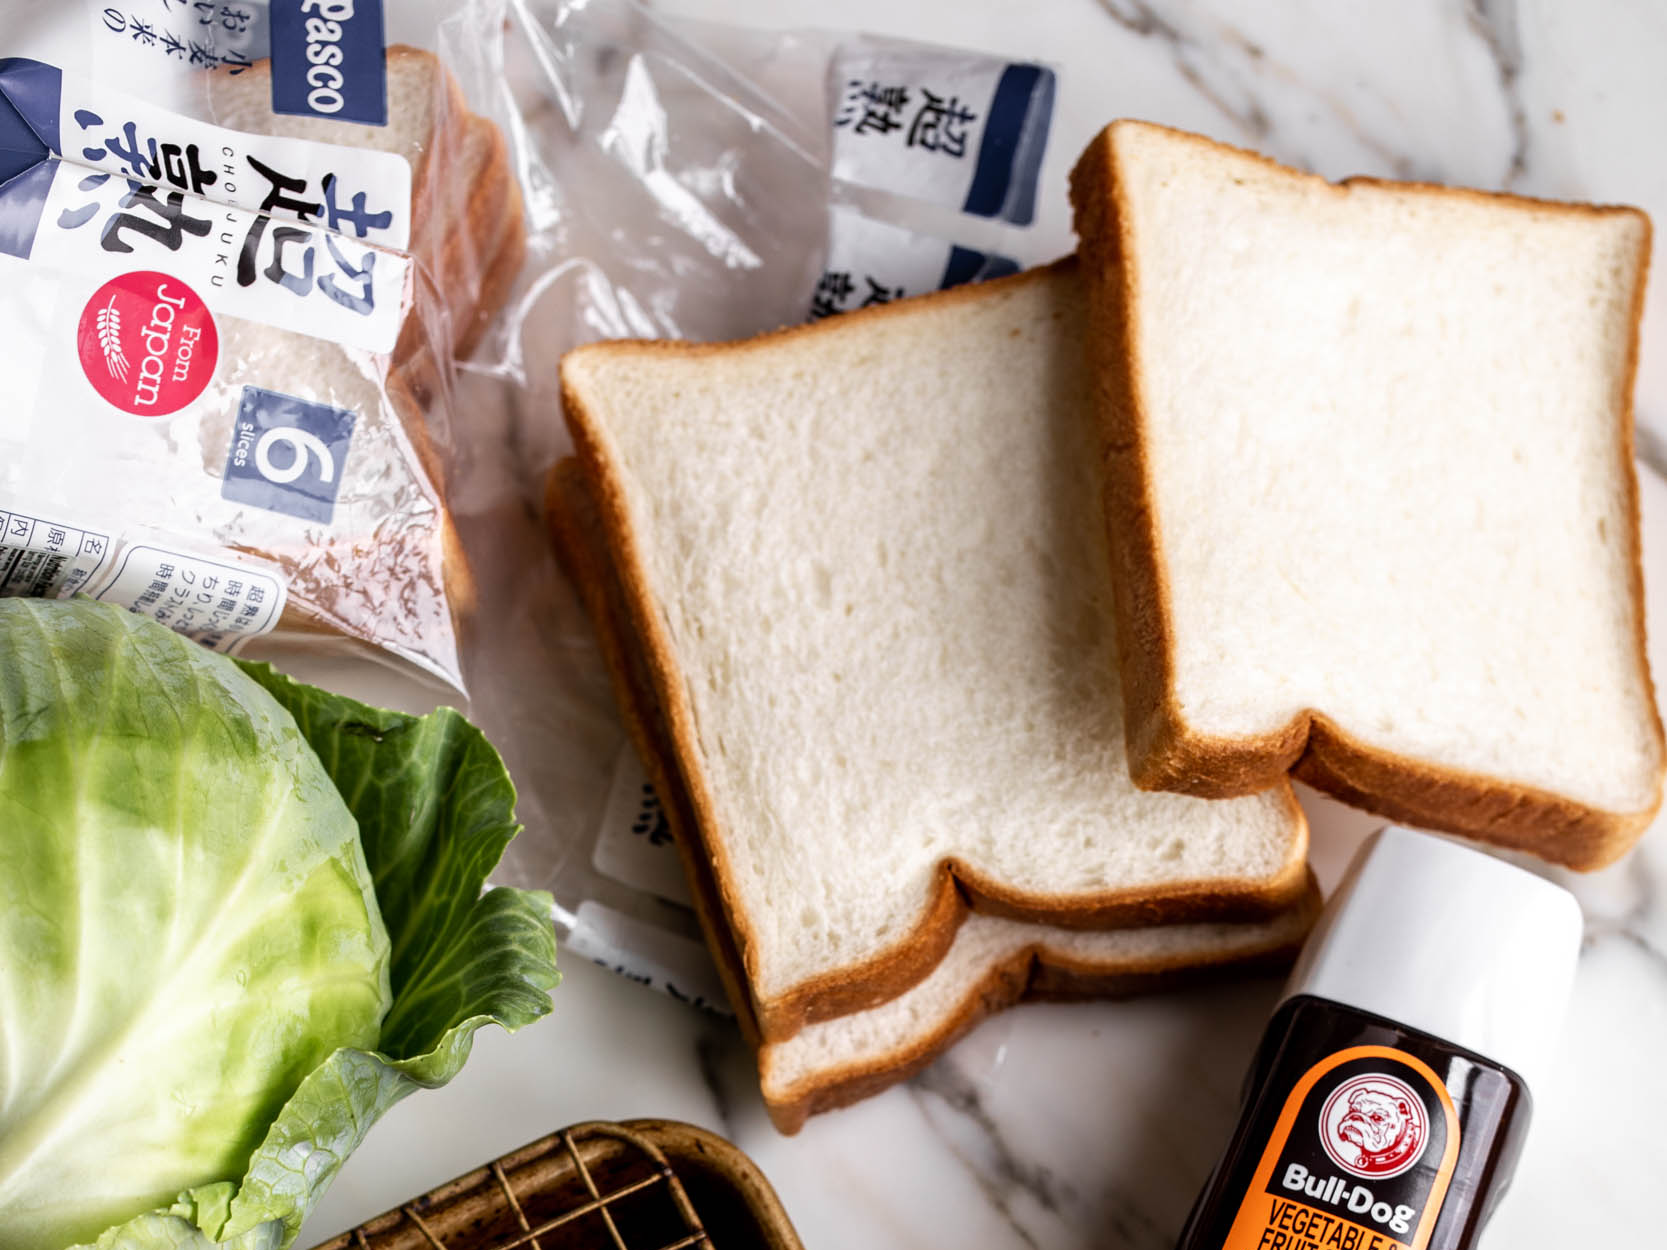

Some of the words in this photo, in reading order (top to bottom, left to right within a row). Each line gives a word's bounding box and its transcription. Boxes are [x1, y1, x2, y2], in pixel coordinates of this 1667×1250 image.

[102, 8, 252, 75] 小麦本来の
[300, 0, 354, 113] Pasco
[833, 79, 977, 158] 超熟
[57, 109, 393, 317] 超熟
[134, 284, 186, 406] Japan
[172, 324, 201, 382] From
[234, 422, 255, 467] slices
[255, 426, 334, 484] 6
[1282, 1163, 1416, 1234] Bull-Dog
